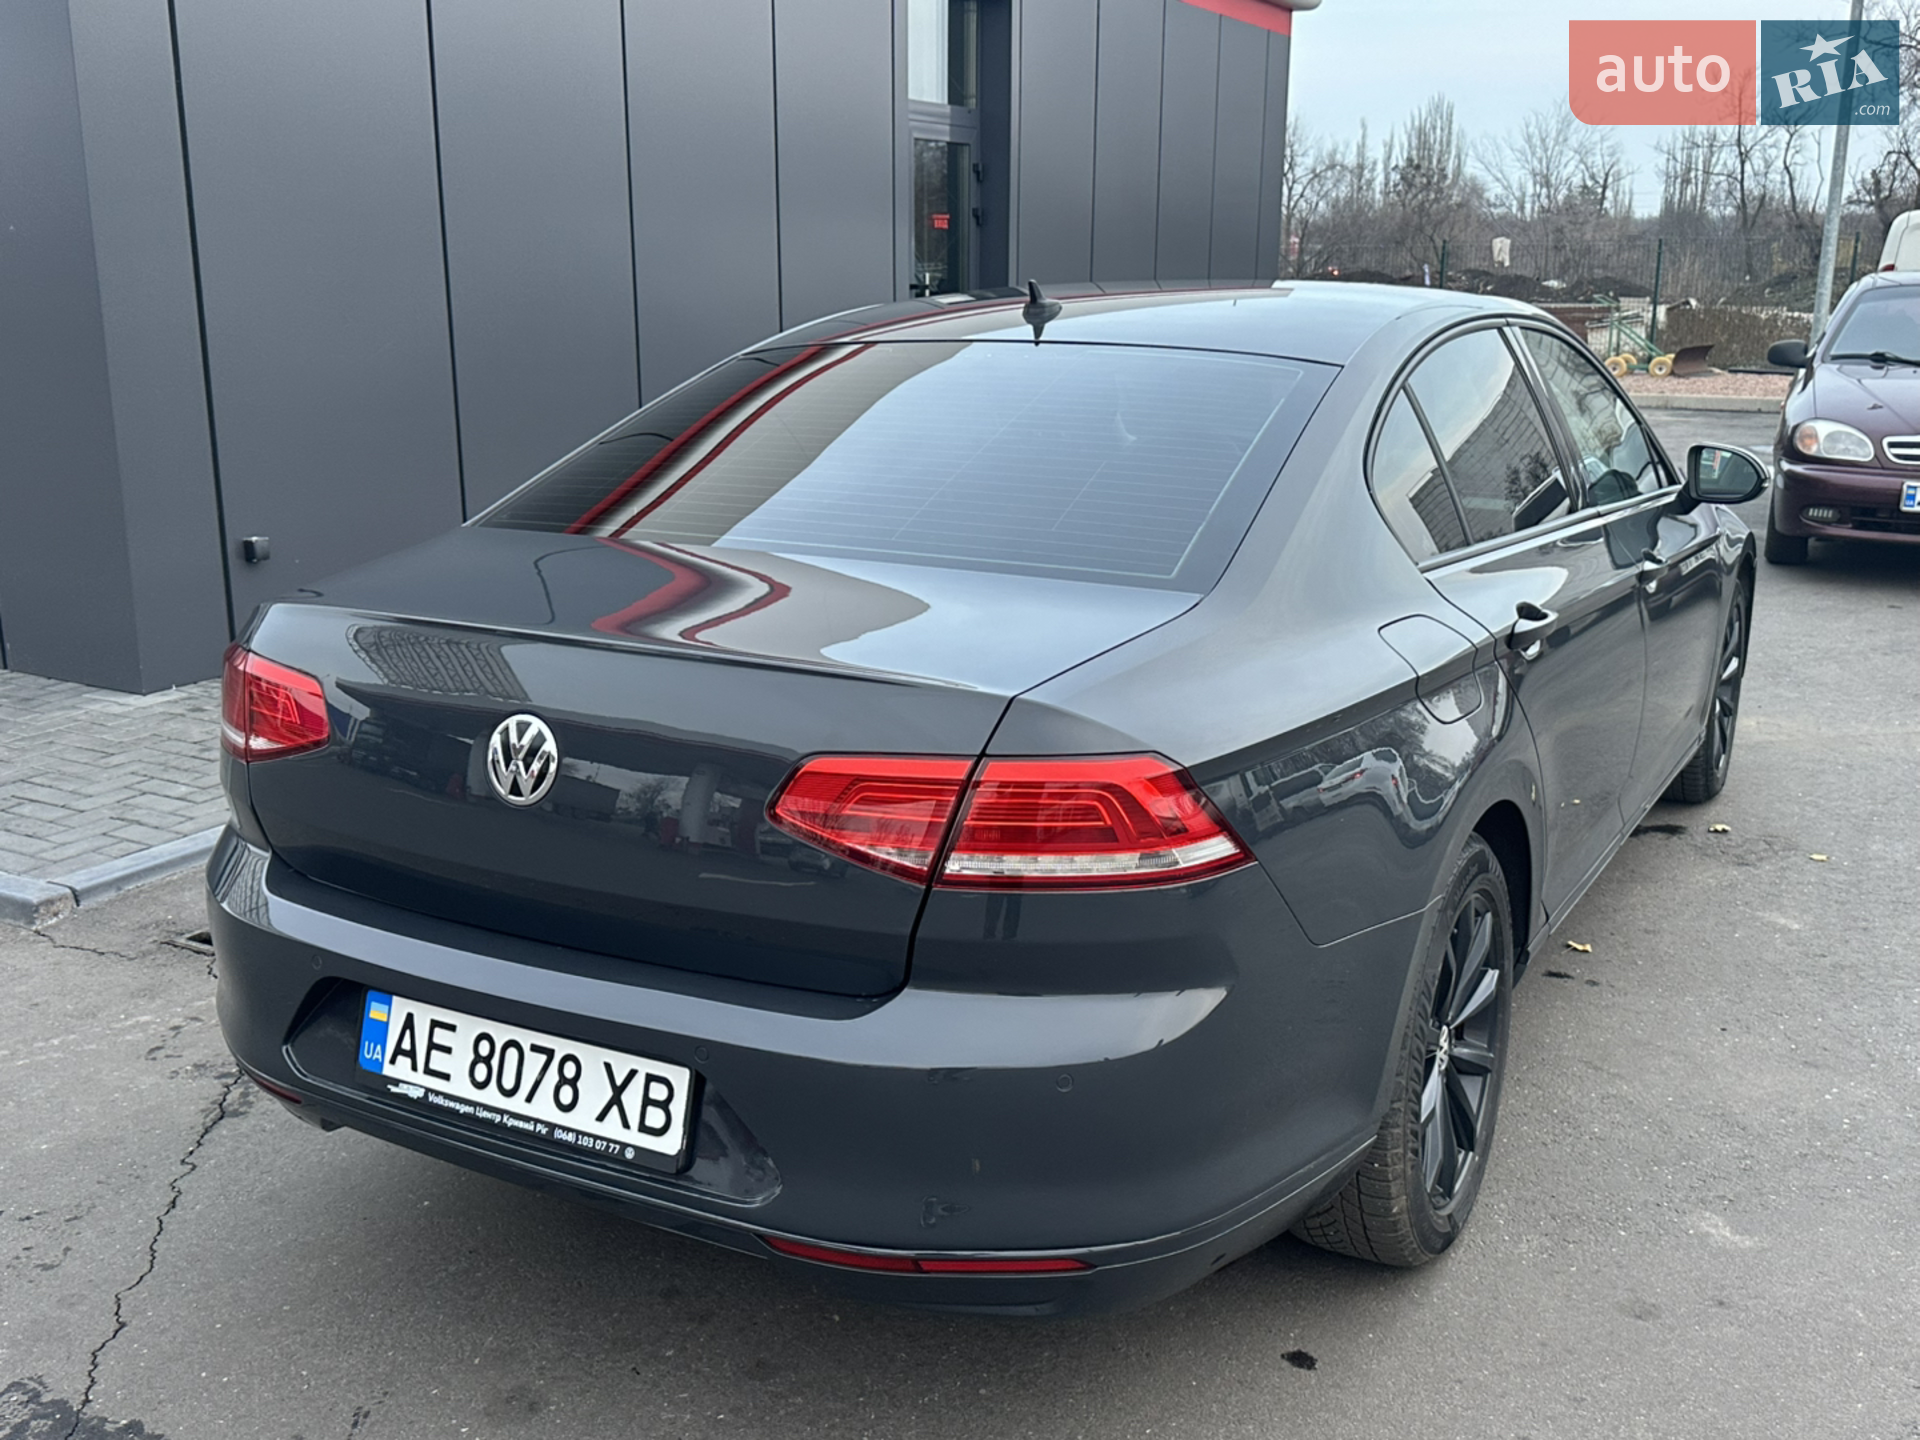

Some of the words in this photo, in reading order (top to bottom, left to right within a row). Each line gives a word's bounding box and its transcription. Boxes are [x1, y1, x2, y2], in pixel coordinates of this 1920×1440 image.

[364, 1041, 383, 1063] UA
[389, 1012, 457, 1082] AE
[468, 1032, 582, 1114] 8078
[595, 1061, 675, 1138] XB
[428, 1091, 475, 1114] Volkswagen
[475, 1106, 502, 1124] Центр
[553, 1127, 577, 1144] (068)
[577, 1134, 594, 1148] 103
[595, 1139, 608, 1151] 07
[608, 1142, 620, 1155] 77
